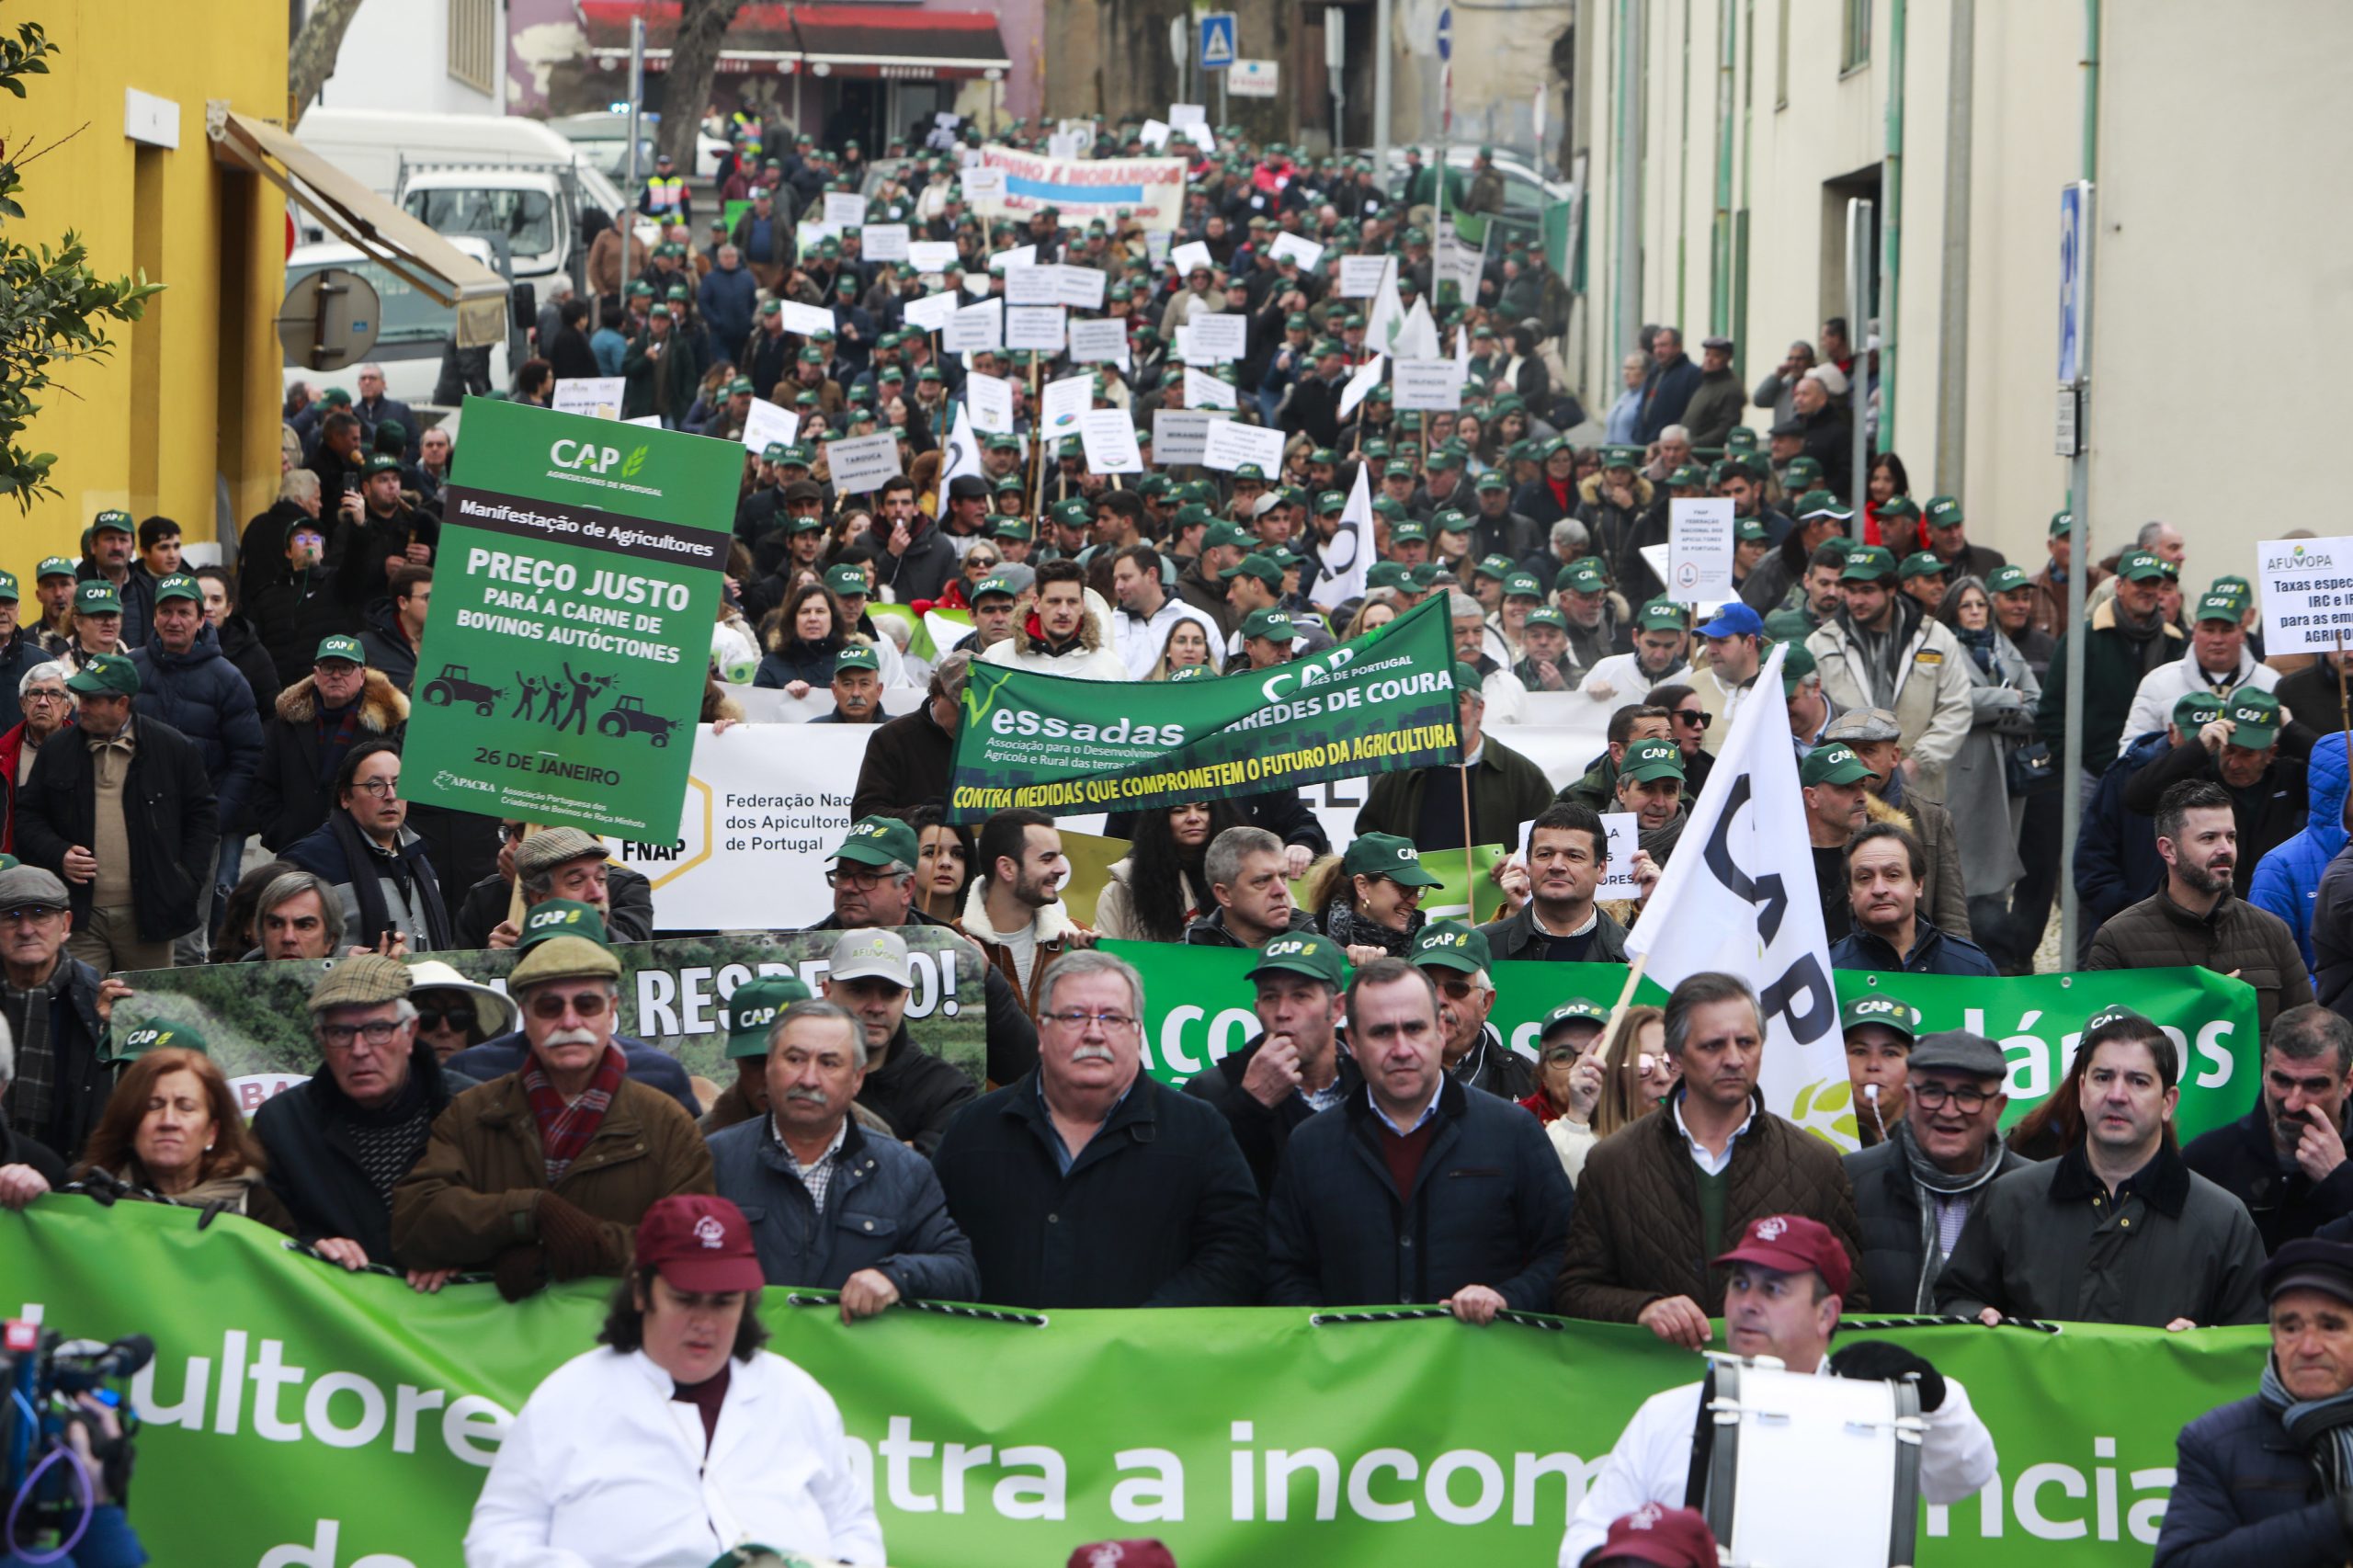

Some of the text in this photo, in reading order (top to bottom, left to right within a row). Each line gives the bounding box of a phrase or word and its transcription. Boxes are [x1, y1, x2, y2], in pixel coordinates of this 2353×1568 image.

[550, 438, 621, 474] CAP
[545, 470, 663, 497] AGRICULTORES DE PORTUGAL
[1934, 501, 1951, 514] CAP
[99, 512, 119, 523] CAP
[460, 499, 714, 558] Manifestação de Agricultores
[41, 557, 59, 569] CAP
[1848, 552, 1868, 564] CAP
[2132, 556, 2154, 567] CAP
[162, 578, 182, 589] CAP
[466, 547, 690, 612] PREÇO JUSTO
[842, 572, 861, 582] CAP
[979, 580, 998, 590] CAP
[1514, 578, 1533, 589] CAP
[86, 589, 107, 598] CAP
[2216, 584, 2237, 594] CAP
[2274, 579, 2312, 593] Taxas
[2206, 597, 2229, 608] CAP
[2308, 594, 2331, 608] IRC
[2334, 596, 2342, 607] e
[541, 598, 558, 617] A
[562, 601, 632, 630] CARNE
[634, 614, 664, 635] DE
[1532, 608, 1552, 619] CAP
[1650, 605, 1671, 616] CAP
[2280, 614, 2311, 629] para
[2313, 614, 2329, 625] as
[456, 608, 681, 665] BOVINOS AUTÓCTONES
[326, 641, 347, 651] CAP
[840, 650, 861, 660] CAP
[1172, 668, 1193, 681] CAP
[1333, 670, 1349, 682] DE
[1351, 654, 1414, 678] PORTUGAL
[1327, 687, 1362, 712] DE
[1366, 669, 1454, 704] COURA
[2192, 710, 2218, 723] CAP
[2236, 707, 2261, 722] CAP
[985, 736, 1044, 753] Associação
[1045, 743, 1071, 755] para
[1073, 745, 1081, 755] o
[1642, 746, 1669, 761] CAP
[983, 748, 1028, 766] Agrícola
[1029, 755, 1038, 764] e
[1039, 755, 1069, 767] Rural
[1071, 756, 1091, 768] das
[1092, 759, 1125, 770] terras
[1828, 748, 1855, 765] CAP
[473, 746, 621, 787] 26 DE JANEIRO
[952, 722, 1458, 809] CONTRA MEDIDAS QUE COMPROMETEM O FUTURO DA AGRICULTURA
[450, 777, 497, 794] APACRA
[502, 786, 608, 812] Associação Portuguesa dos
[726, 793, 814, 811] Federação
[500, 796, 646, 829] Criadores de Bovinos de Raça Minhota
[726, 815, 756, 829] dos
[848, 824, 874, 837] CAP
[726, 836, 824, 854] de Portugal
[529, 910, 566, 928] CAP
[1266, 939, 1302, 957] CAP
[1422, 931, 1455, 949] CAP
[1552, 1001, 1591, 1020] CAP
[1856, 999, 1892, 1015] CAP
[740, 1006, 778, 1028] CAP
[127, 1029, 157, 1047] CAP
[1109, 1447, 1185, 1522] a
